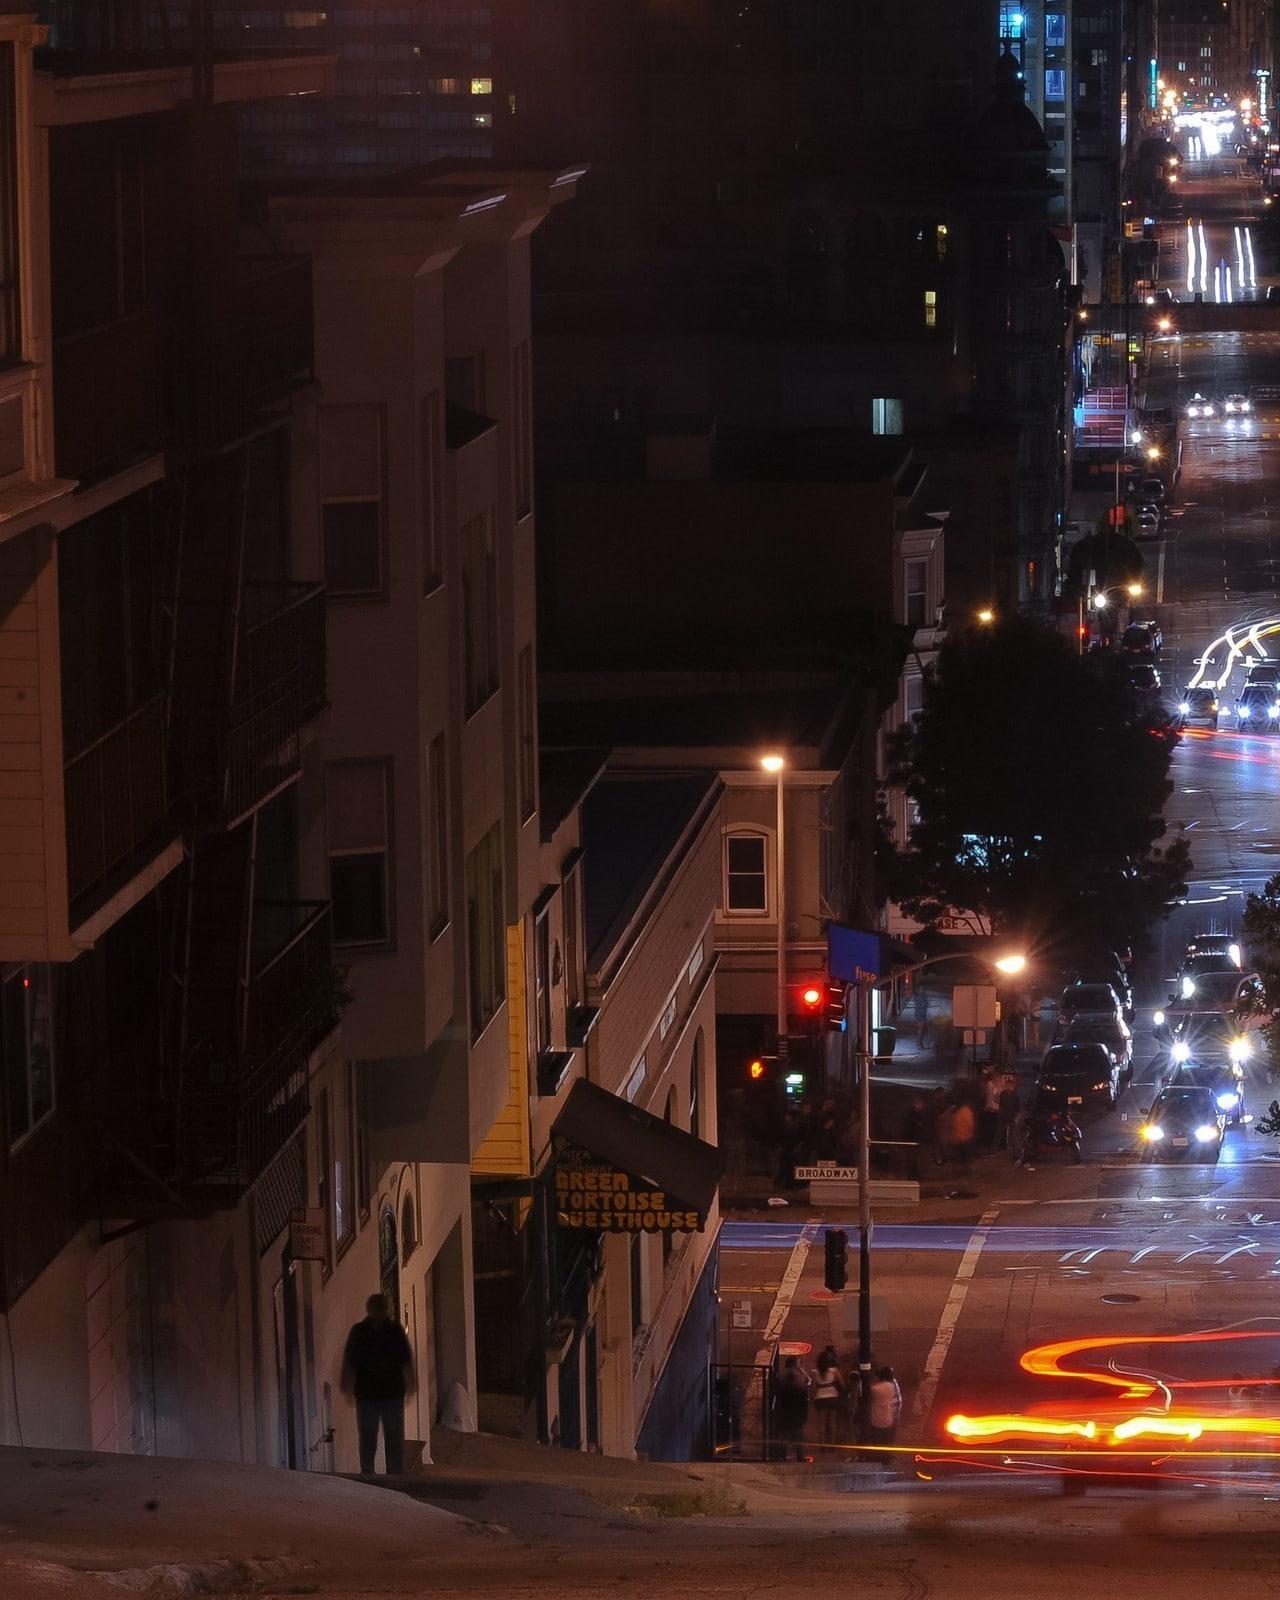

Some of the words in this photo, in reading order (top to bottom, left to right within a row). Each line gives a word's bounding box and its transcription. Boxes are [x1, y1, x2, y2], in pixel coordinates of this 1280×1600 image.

[555, 1171, 629, 1191] GREEN
[798, 1169, 856, 1178] BROADWAY
[557, 1191, 665, 1210] TORTOISE
[557, 1211, 699, 1228] GUESTHOUSE
